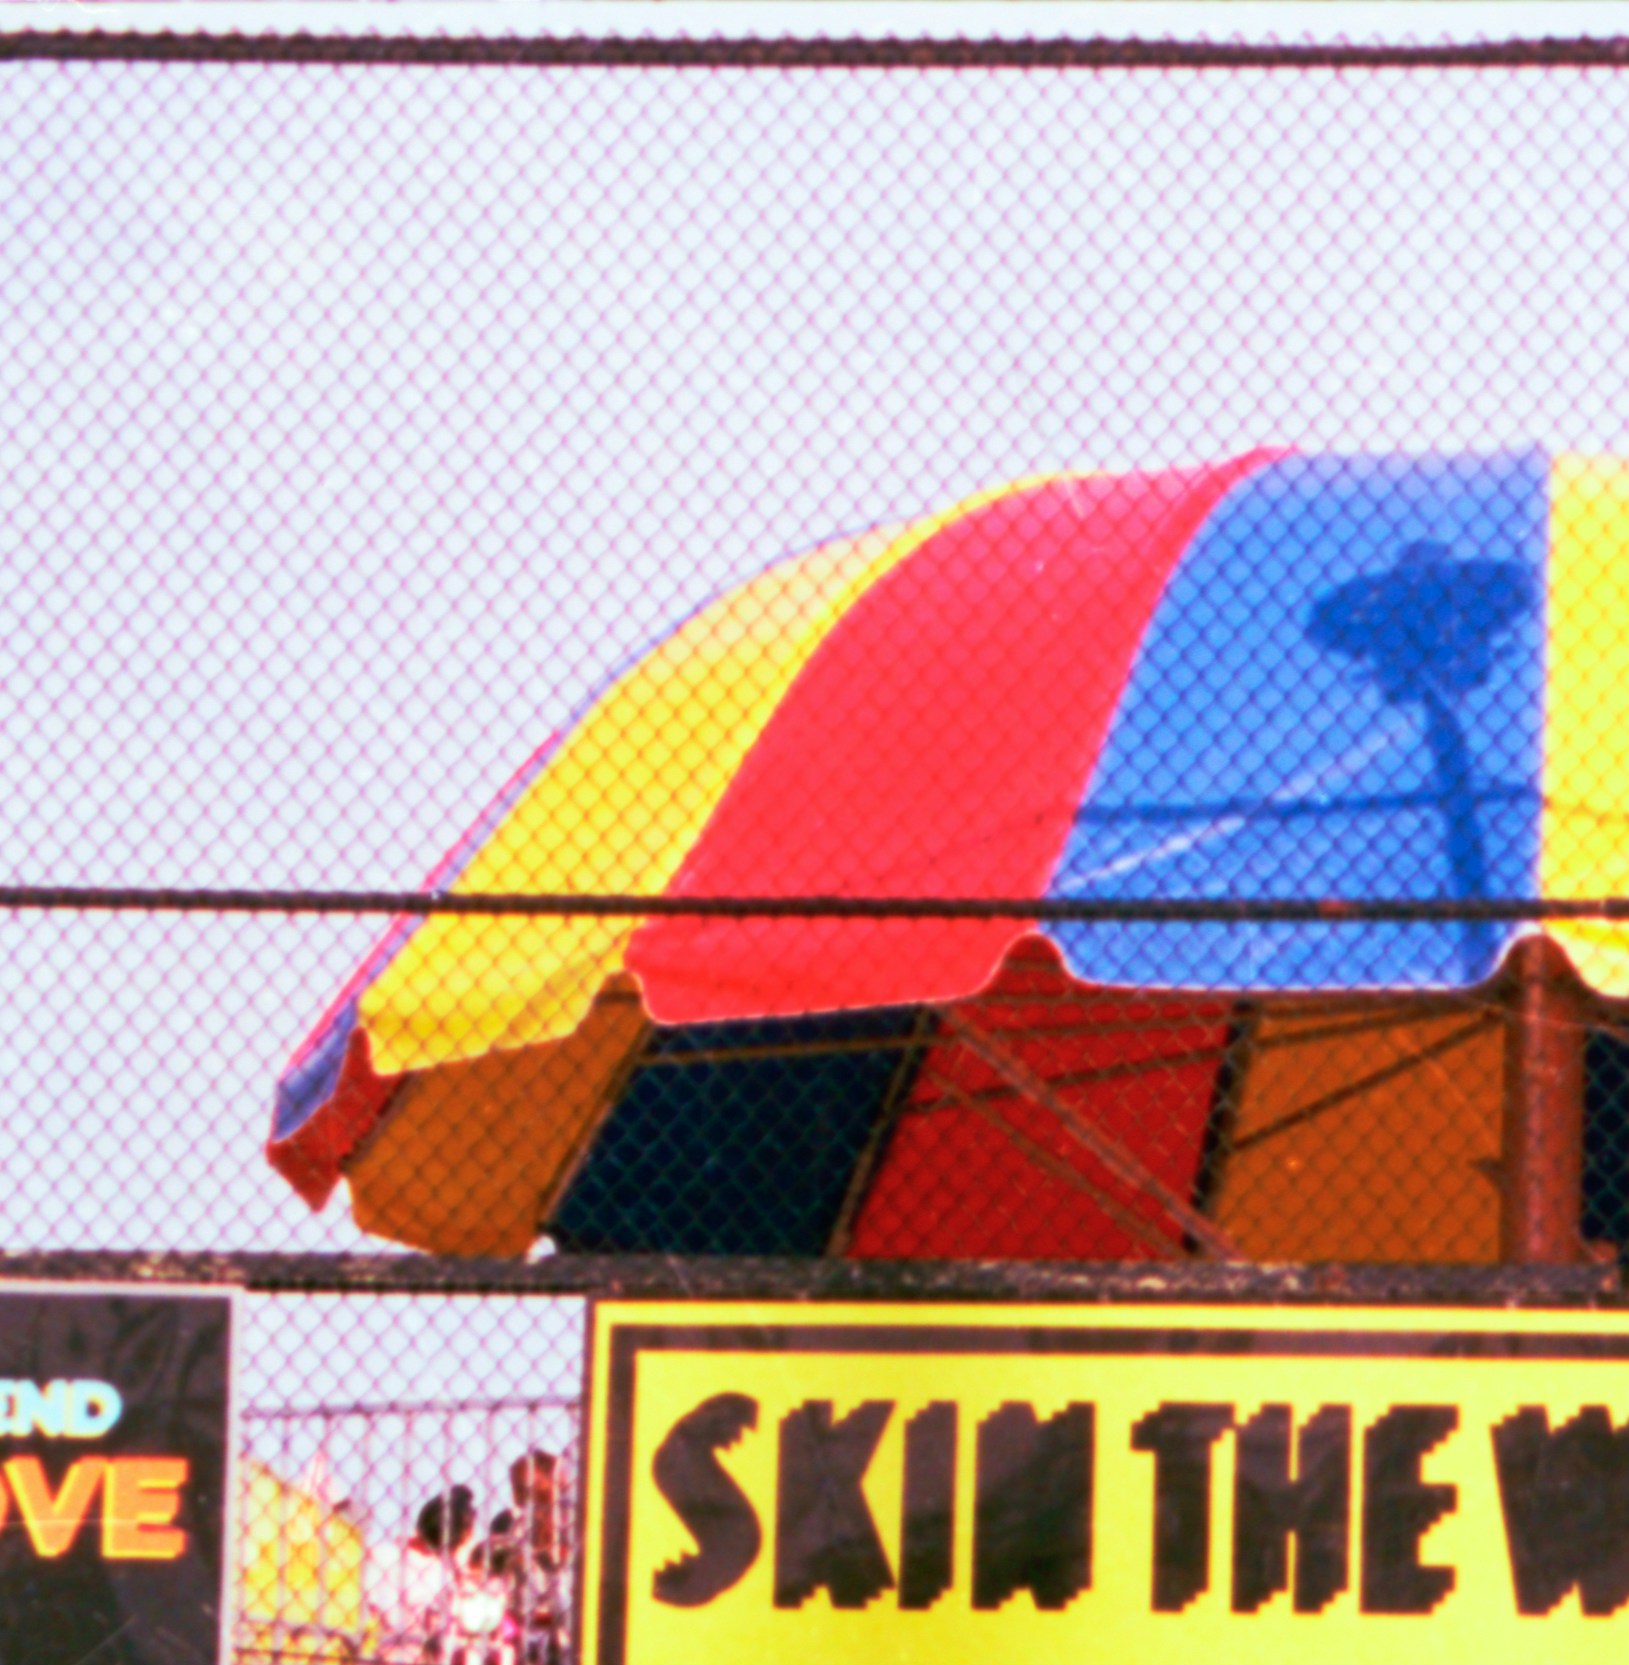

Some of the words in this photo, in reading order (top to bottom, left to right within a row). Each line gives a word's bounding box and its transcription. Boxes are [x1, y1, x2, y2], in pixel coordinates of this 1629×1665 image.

[0, 1454, 188, 1560] VE
[651, 1392, 1096, 1611] SKIN
[1131, 1401, 1460, 1616] THE
